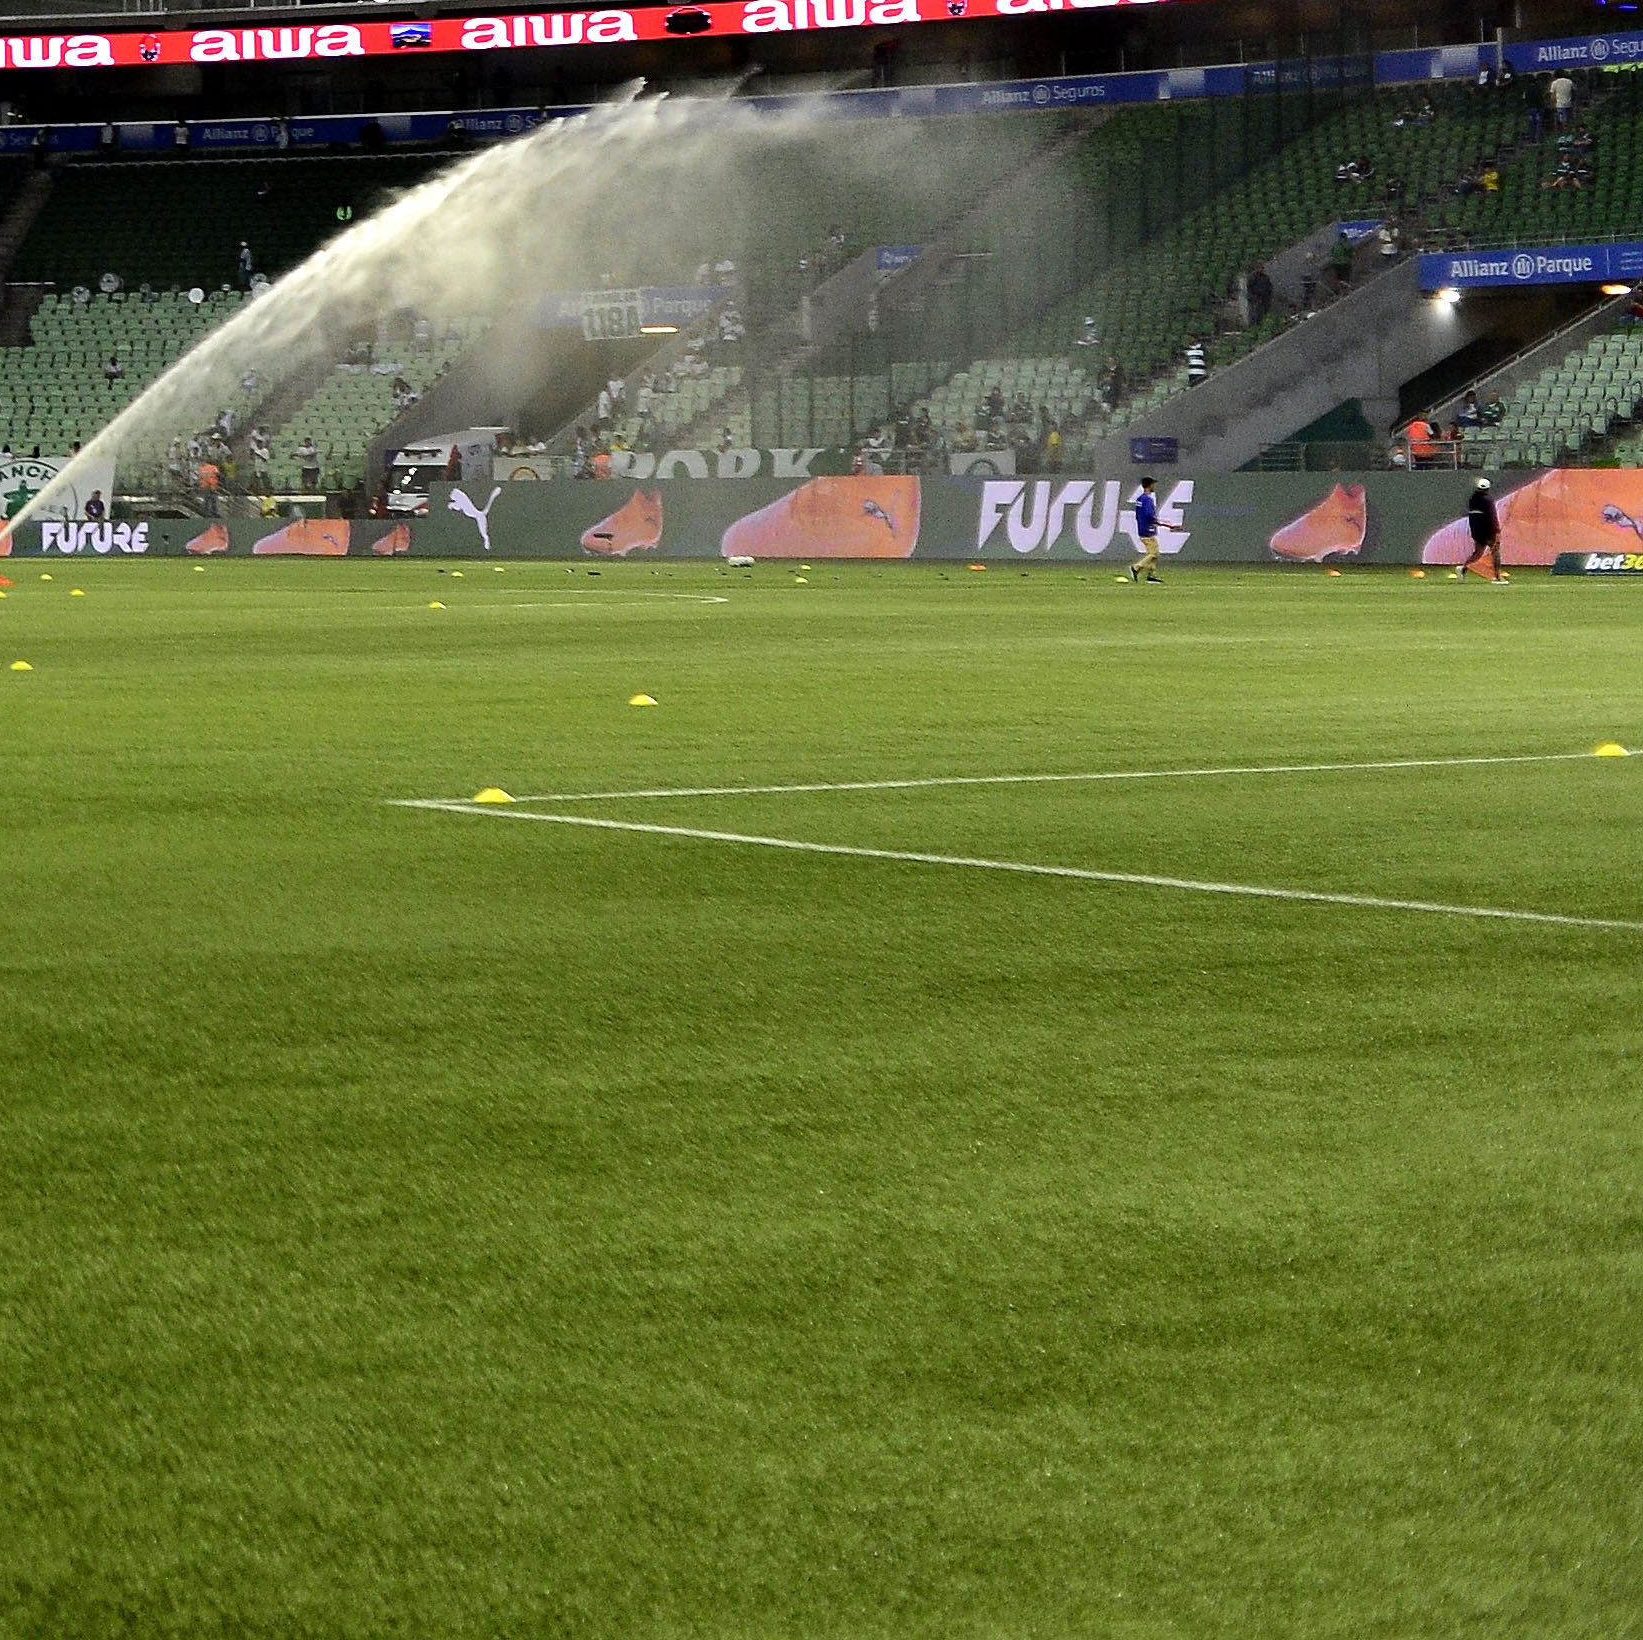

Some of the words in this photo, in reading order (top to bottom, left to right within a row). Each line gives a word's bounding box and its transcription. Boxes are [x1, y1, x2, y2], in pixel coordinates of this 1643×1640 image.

[461, 10, 637, 50] aiwa
[191, 25, 365, 61] aiwa
[1537, 44, 1588, 63] Allianz
[1613, 39, 1643, 59] Segu
[983, 90, 1030, 105] Allianz
[1054, 83, 1106, 102] Seguros
[203, 128, 250, 141] Allianz
[271, 126, 315, 142] Pque
[463, 116, 503, 131] llianz
[1451, 259, 1509, 278] Allianz
[1537, 255, 1593, 278] Parque
[41, 521, 149, 554] FUTURE
